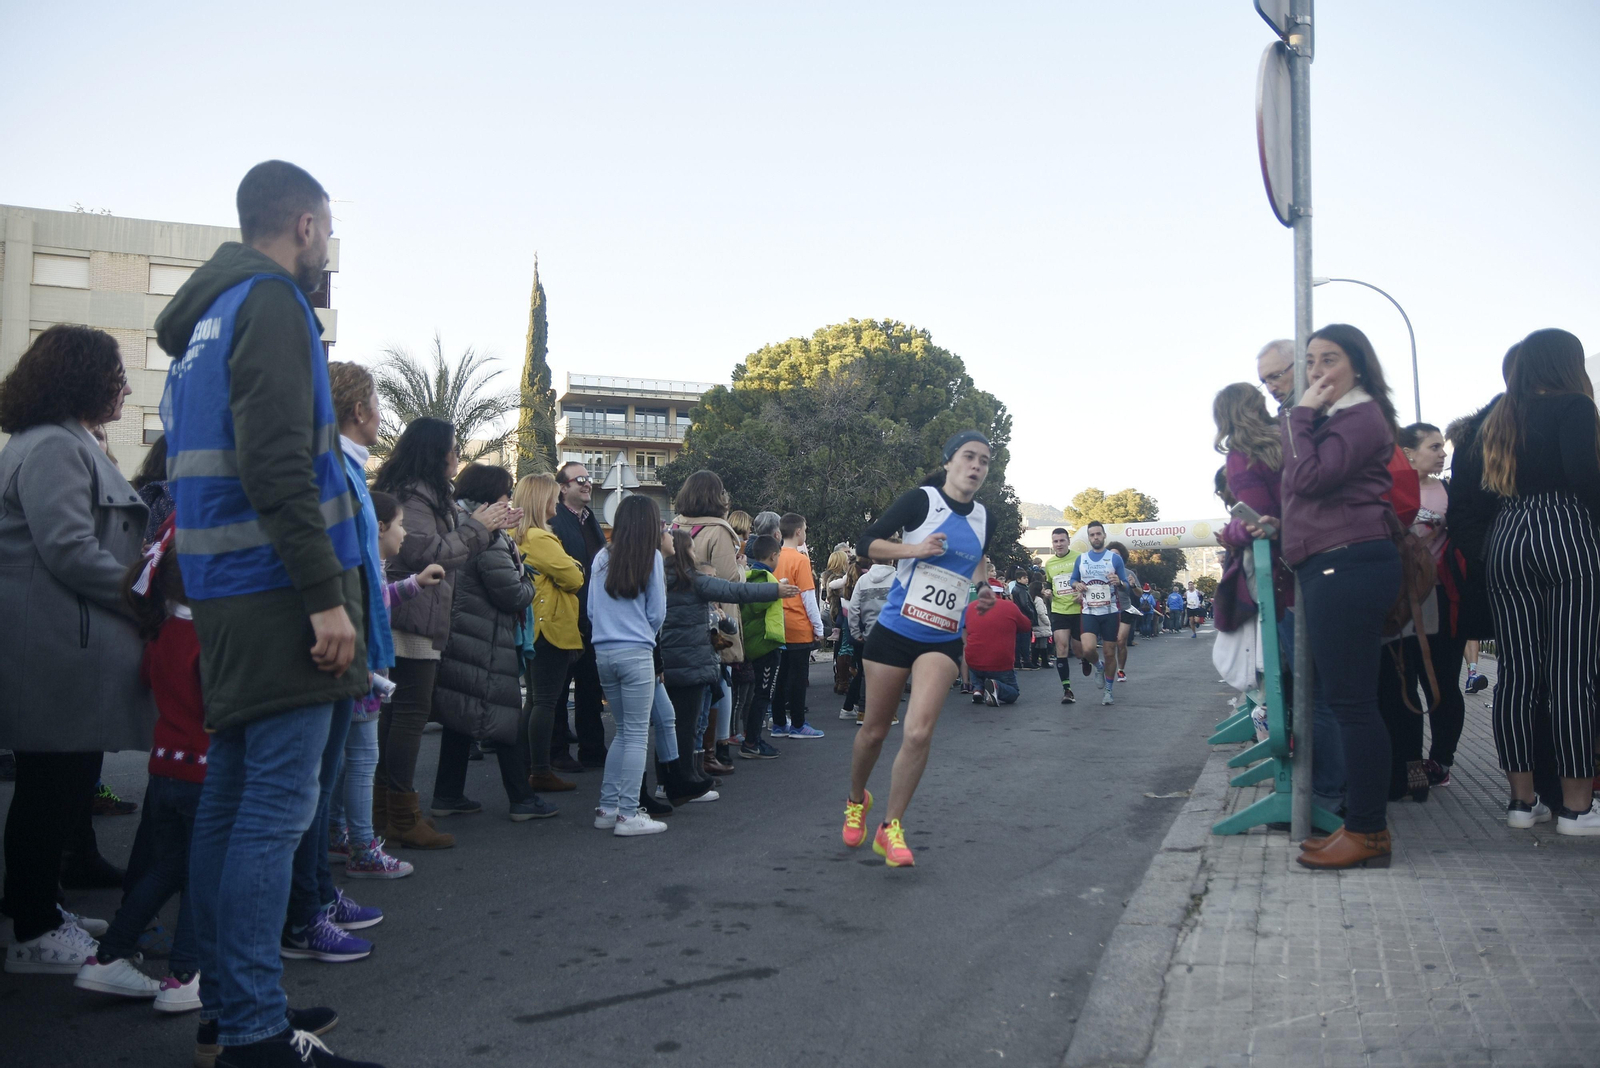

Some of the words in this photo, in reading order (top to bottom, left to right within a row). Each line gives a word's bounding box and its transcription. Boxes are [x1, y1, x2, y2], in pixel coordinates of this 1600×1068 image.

[1125, 526, 1186, 537] Cruzcampo
[1132, 539, 1161, 548] Radler
[921, 585, 957, 610] 208
[1091, 592, 1106, 600] 963
[907, 605, 951, 628] Cruzcampo
